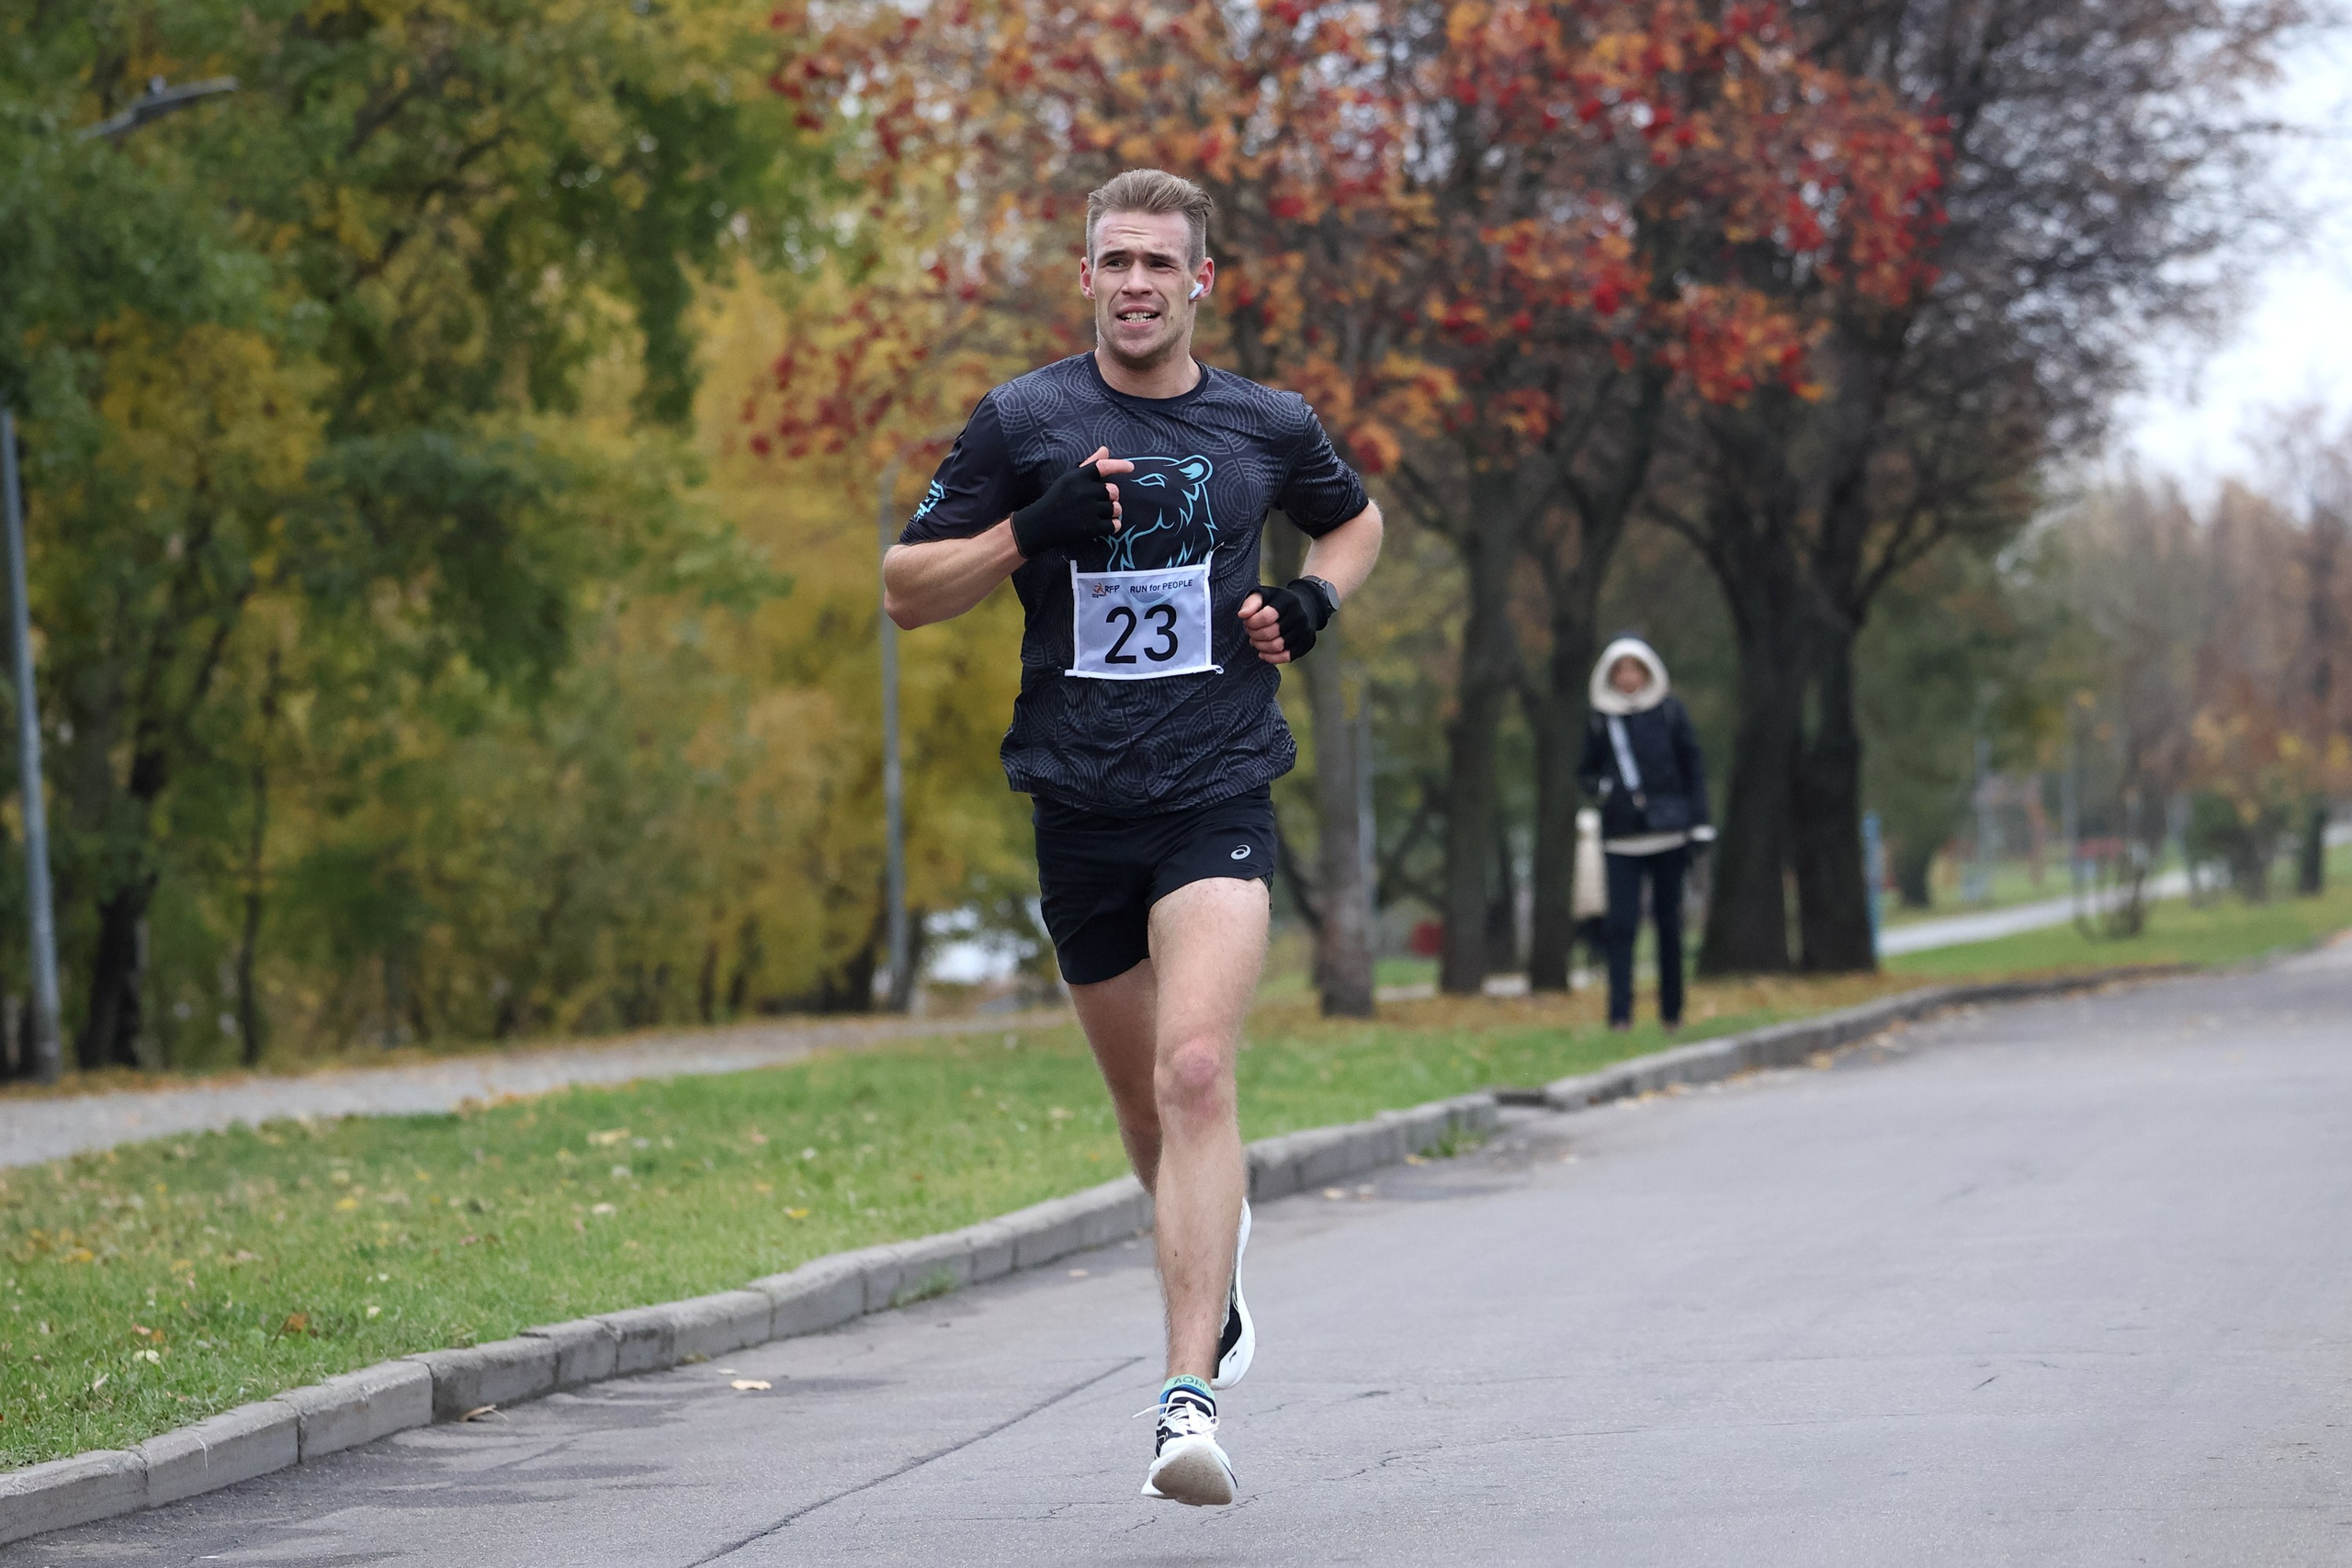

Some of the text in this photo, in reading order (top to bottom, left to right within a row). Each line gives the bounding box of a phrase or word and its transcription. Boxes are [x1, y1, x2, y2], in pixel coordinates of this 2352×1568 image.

[1104, 584, 1120, 594] RFP
[1129, 579, 1193, 593] RUN for PEOPLE
[1105, 604, 1178, 663] 23
